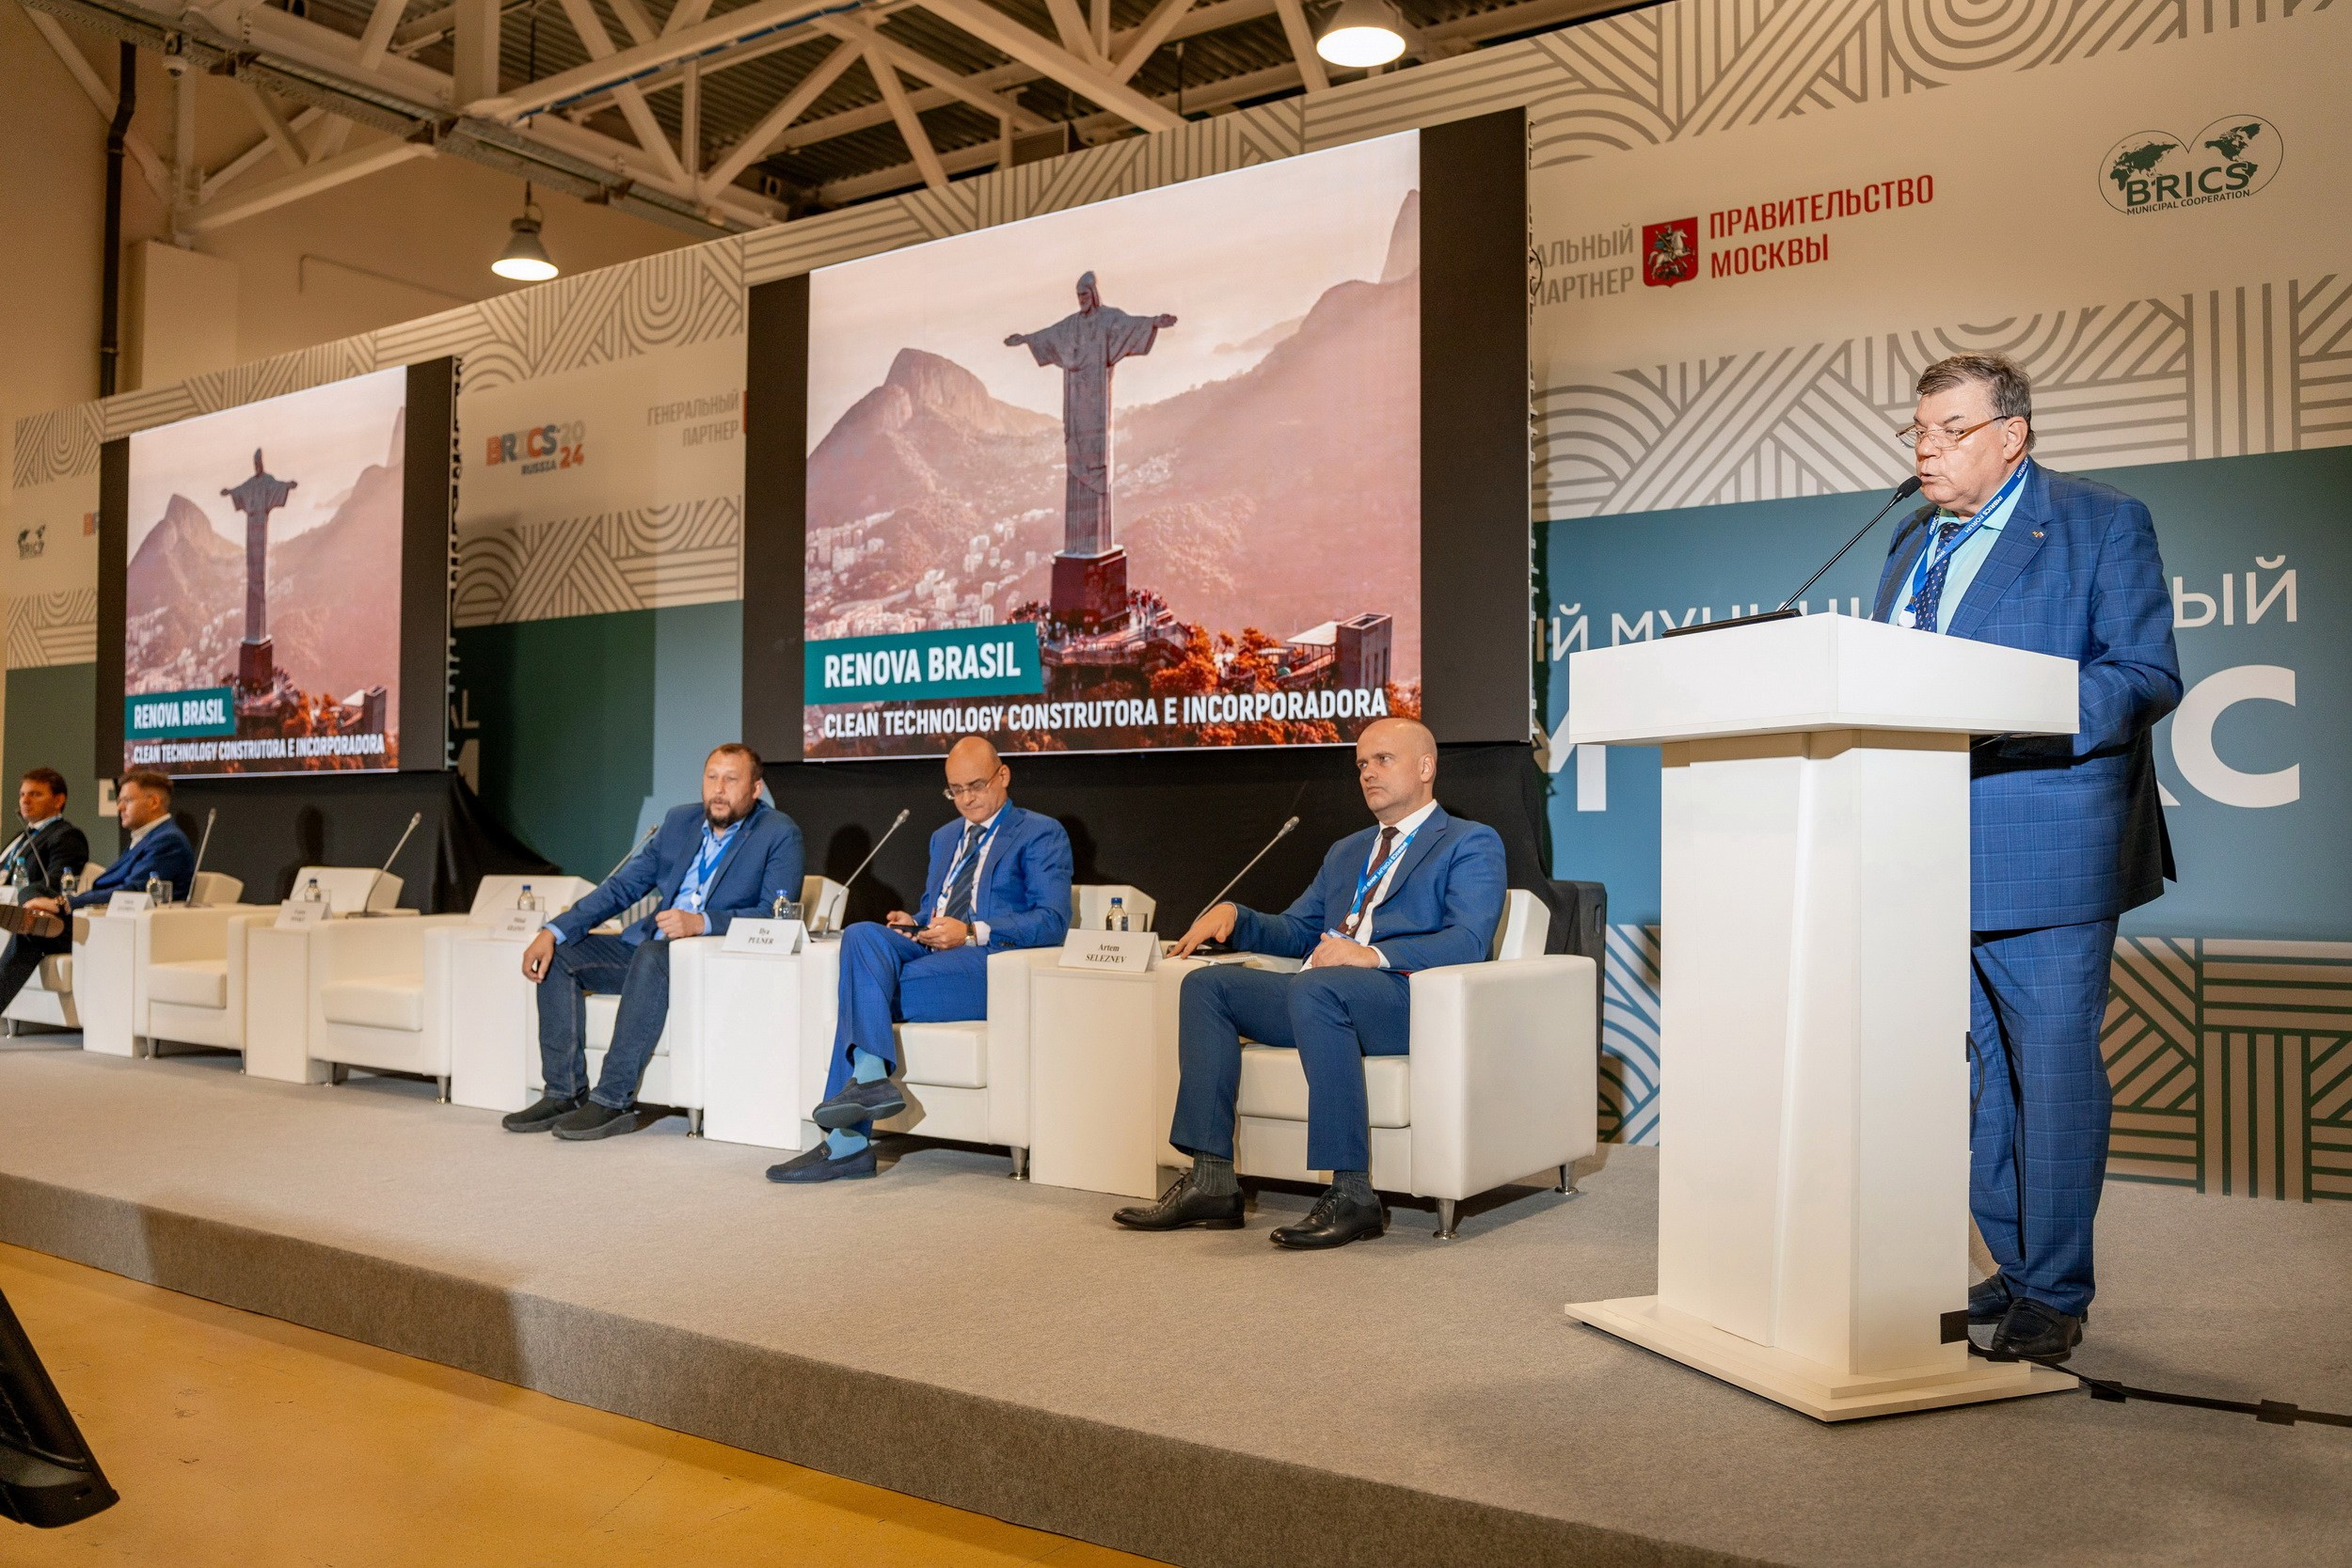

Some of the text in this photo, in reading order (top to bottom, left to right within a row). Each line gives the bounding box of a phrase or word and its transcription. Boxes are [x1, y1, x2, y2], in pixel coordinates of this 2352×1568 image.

[2126, 189, 2250, 215] MUNICIPAL COOPERATION
[2127, 162, 2249, 206] BRICS
[1710, 174, 1934, 239] ПРАВИТЕЛЬСТВО
[1710, 233, 1829, 278] МОСКВЫ
[485, 424, 559, 467] BRICS
[682, 420, 739, 447] ПАРТНЕР
[1964, 496, 2004, 533] IMBRICS FORUM
[824, 641, 1022, 689] RENOVA BRASIL
[134, 698, 227, 729] RENOVA BRASIL
[824, 688, 1389, 738] CLEAN TECHNOLOGY CONSTRUTORA E INCORPORADORA
[134, 733, 386, 764] CLEAN TECHNOLOGY CONSTRUTORA E INCORPORADORA
[1085, 954, 1127, 963] SELEZNEV
[1098, 943, 1120, 952] Artem
